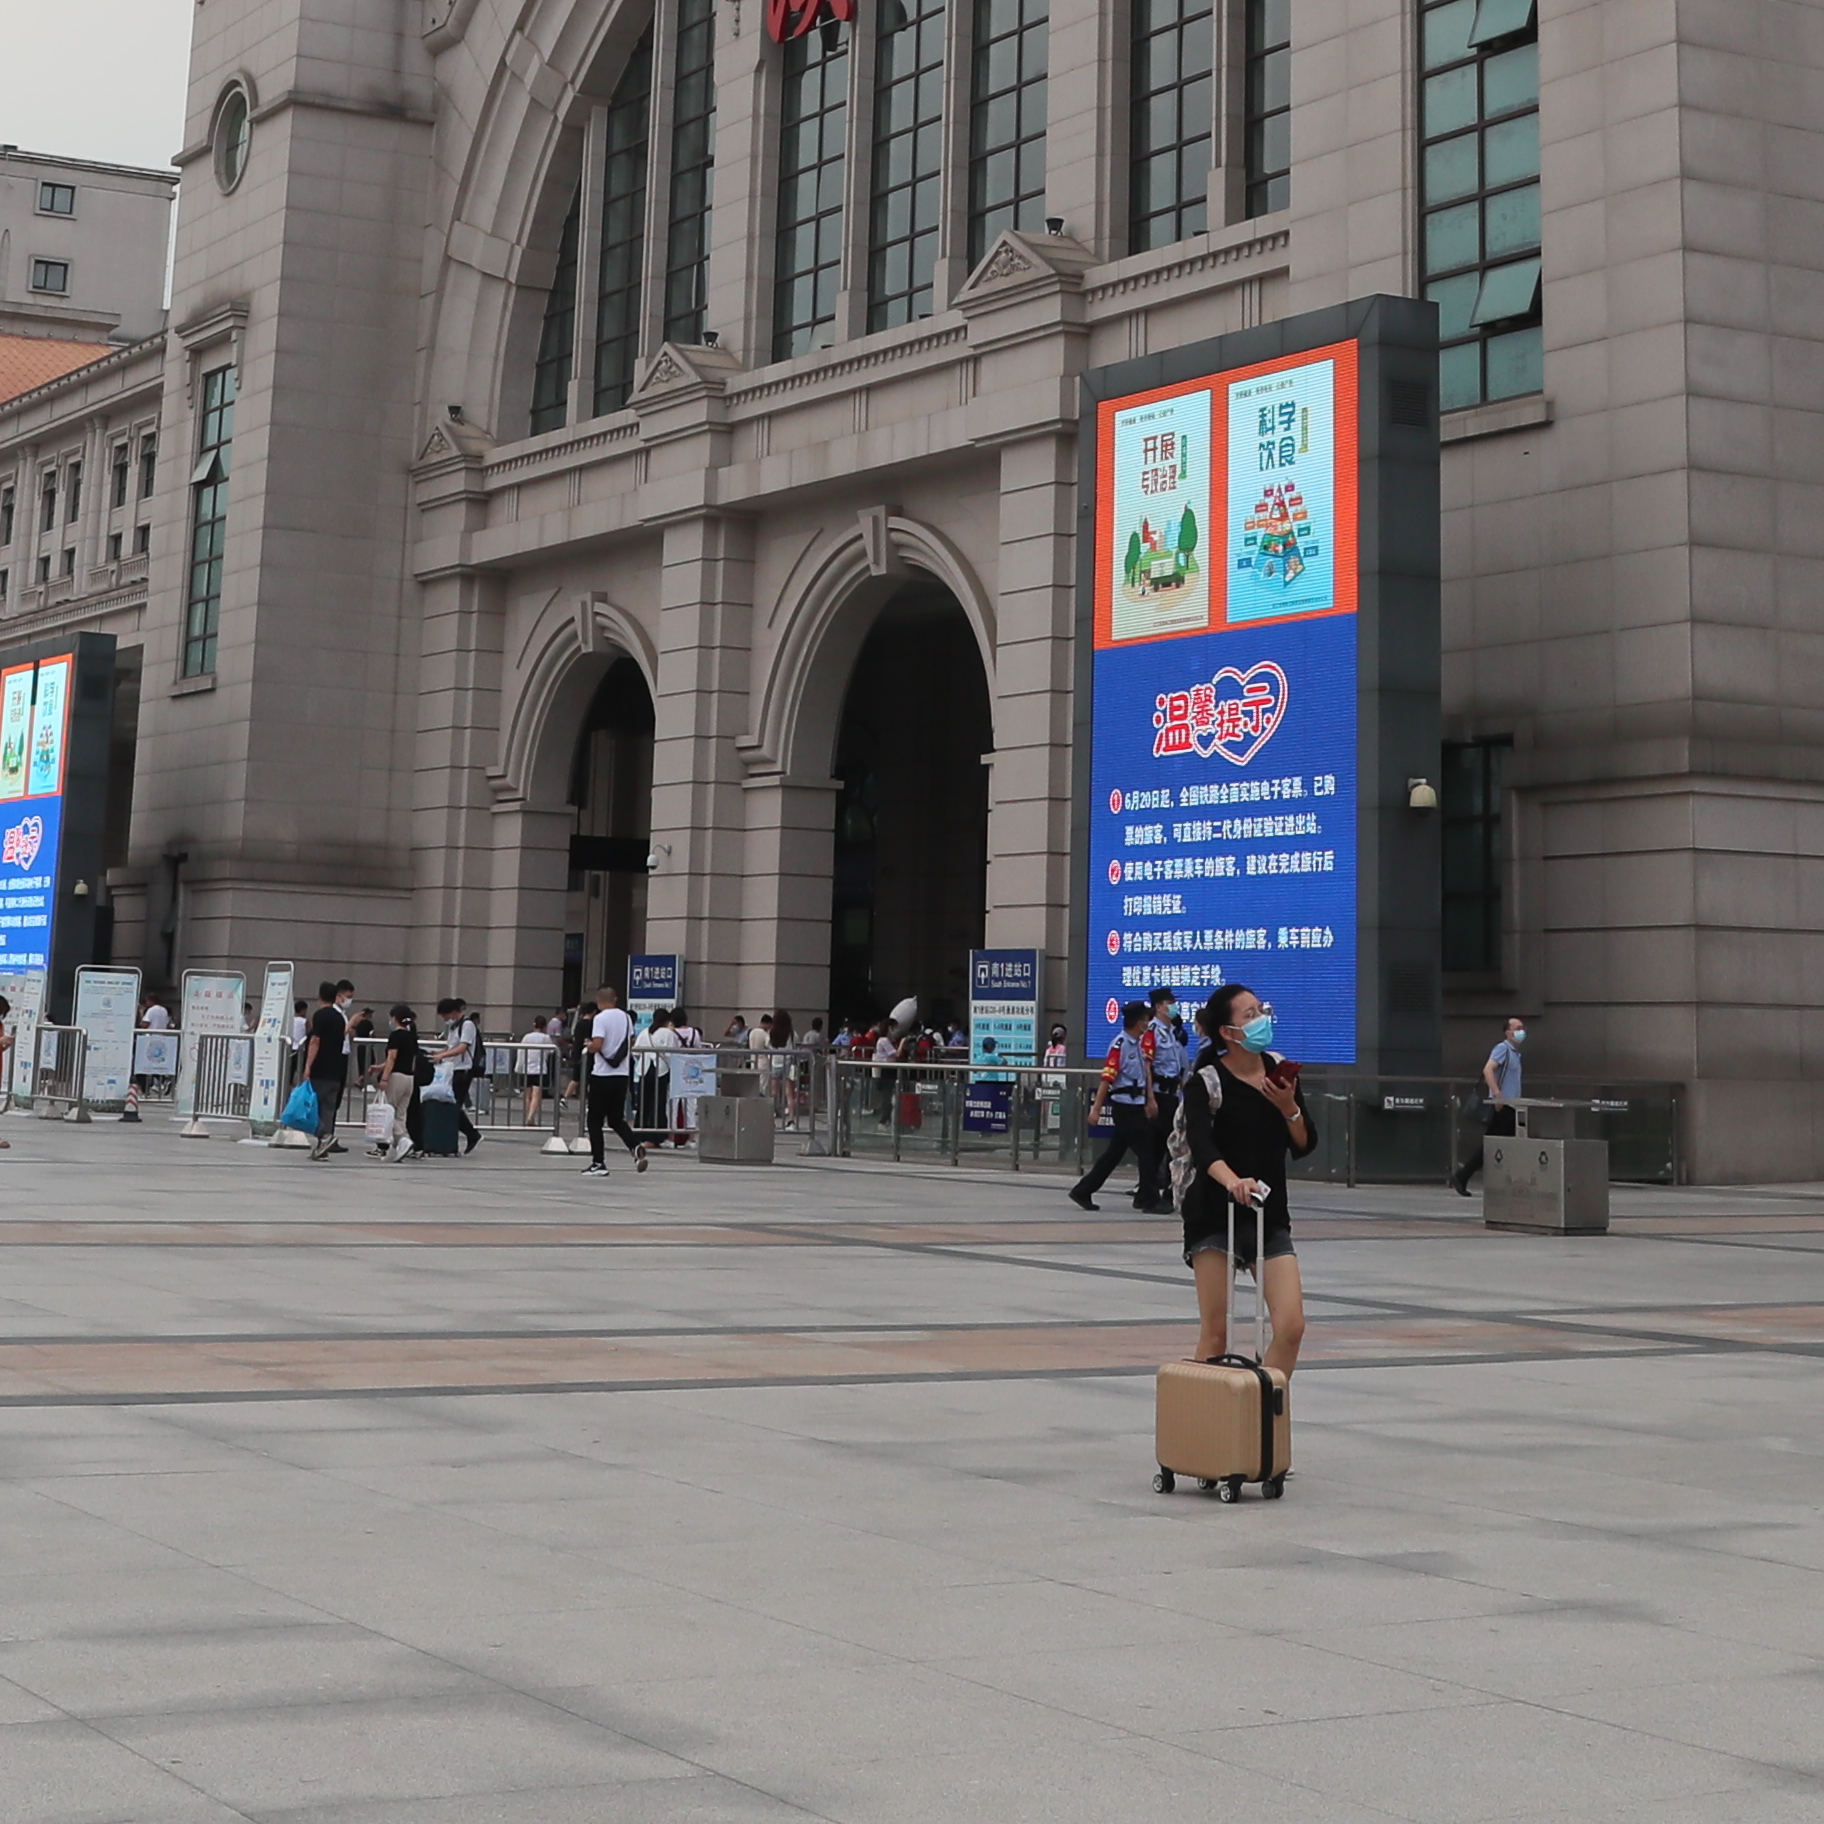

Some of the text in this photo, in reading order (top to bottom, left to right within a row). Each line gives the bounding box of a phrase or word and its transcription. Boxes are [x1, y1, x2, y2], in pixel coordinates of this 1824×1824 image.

[1258, 400, 1296, 437] 科学
[1142, 431, 1176, 465] 开展
[1258, 435, 1296, 472] 饮食
[1152, 684, 1275, 757] 温馨提示
[991, 961, 1032, 978] 南1进站口
